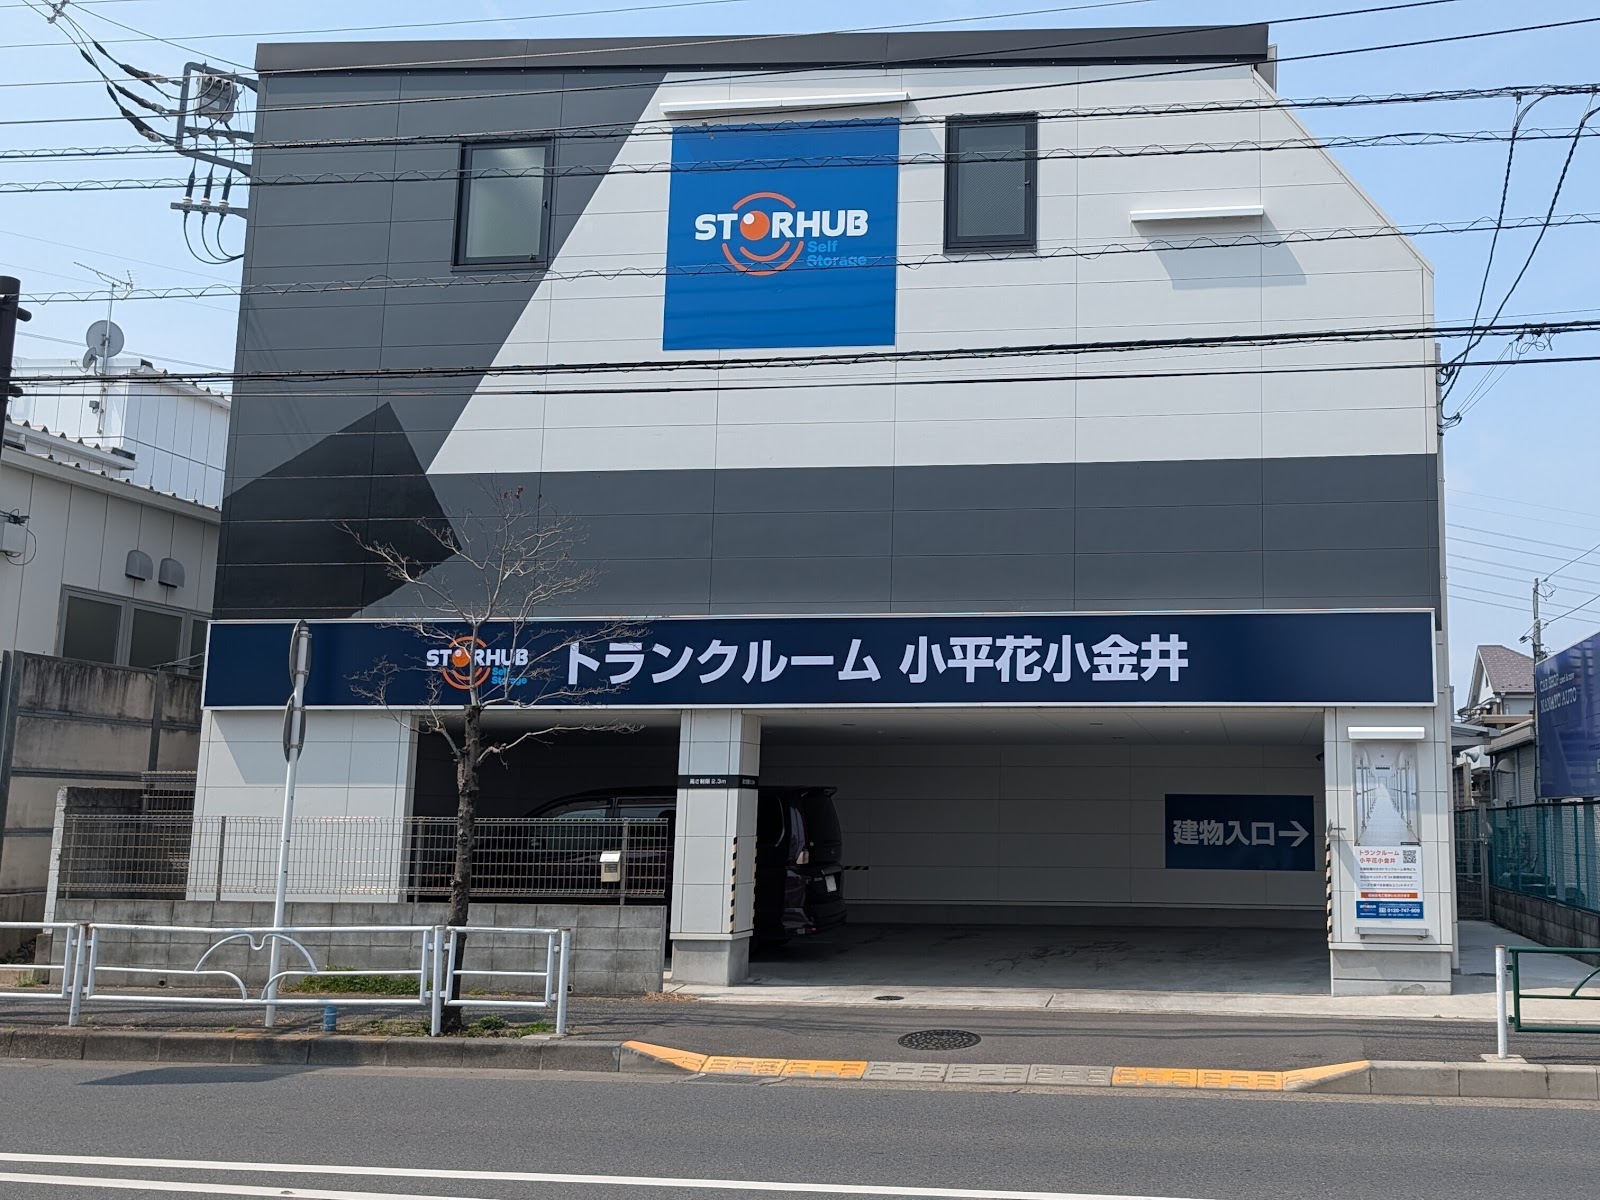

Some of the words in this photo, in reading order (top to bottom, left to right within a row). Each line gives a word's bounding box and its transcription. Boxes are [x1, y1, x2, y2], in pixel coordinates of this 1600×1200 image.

[694, 209, 869, 241] STORHUB
[807, 240, 838, 253] Self
[806, 254, 868, 269] Storage
[426, 648, 529, 667] STORHUB
[568, 639, 882, 685] トランクルーム
[899, 633, 1189, 683] 小平花小金井
[1562, 687, 1577, 706] AUTO
[1173, 819, 1275, 846] 建物入口
